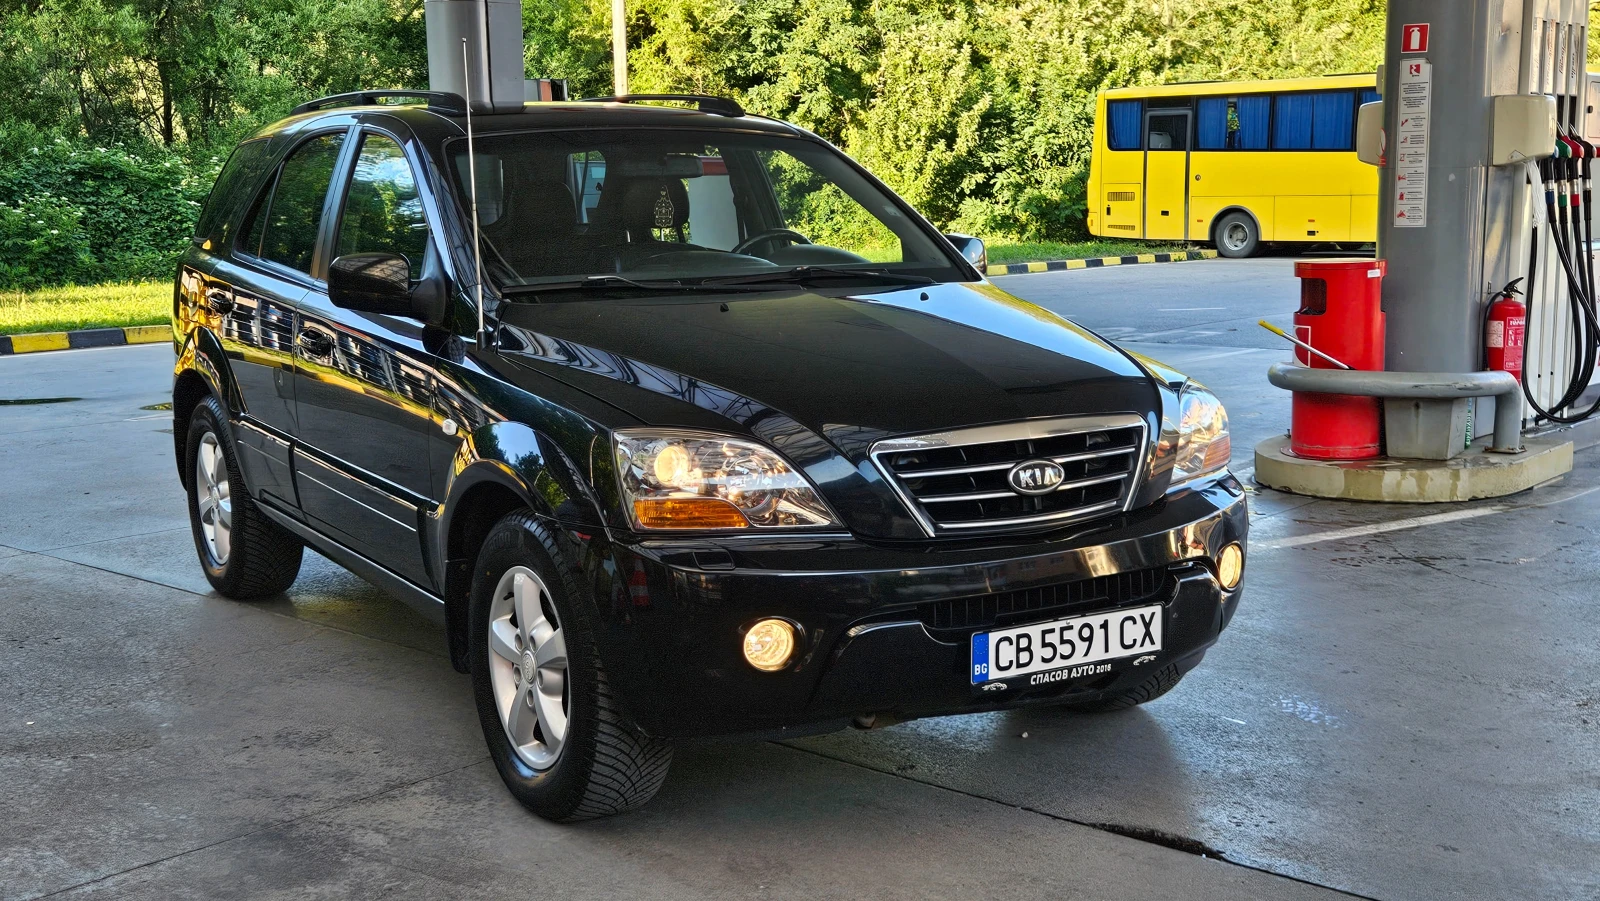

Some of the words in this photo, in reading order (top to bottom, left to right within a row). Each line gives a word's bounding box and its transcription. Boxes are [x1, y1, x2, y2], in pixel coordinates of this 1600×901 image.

[1018, 467, 1061, 488] KIA
[1040, 619, 1110, 664] 5591
[974, 663, 988, 675] BG
[1030, 669, 1068, 685] СПАСОВ
[1070, 664, 1095, 679] АУТО
